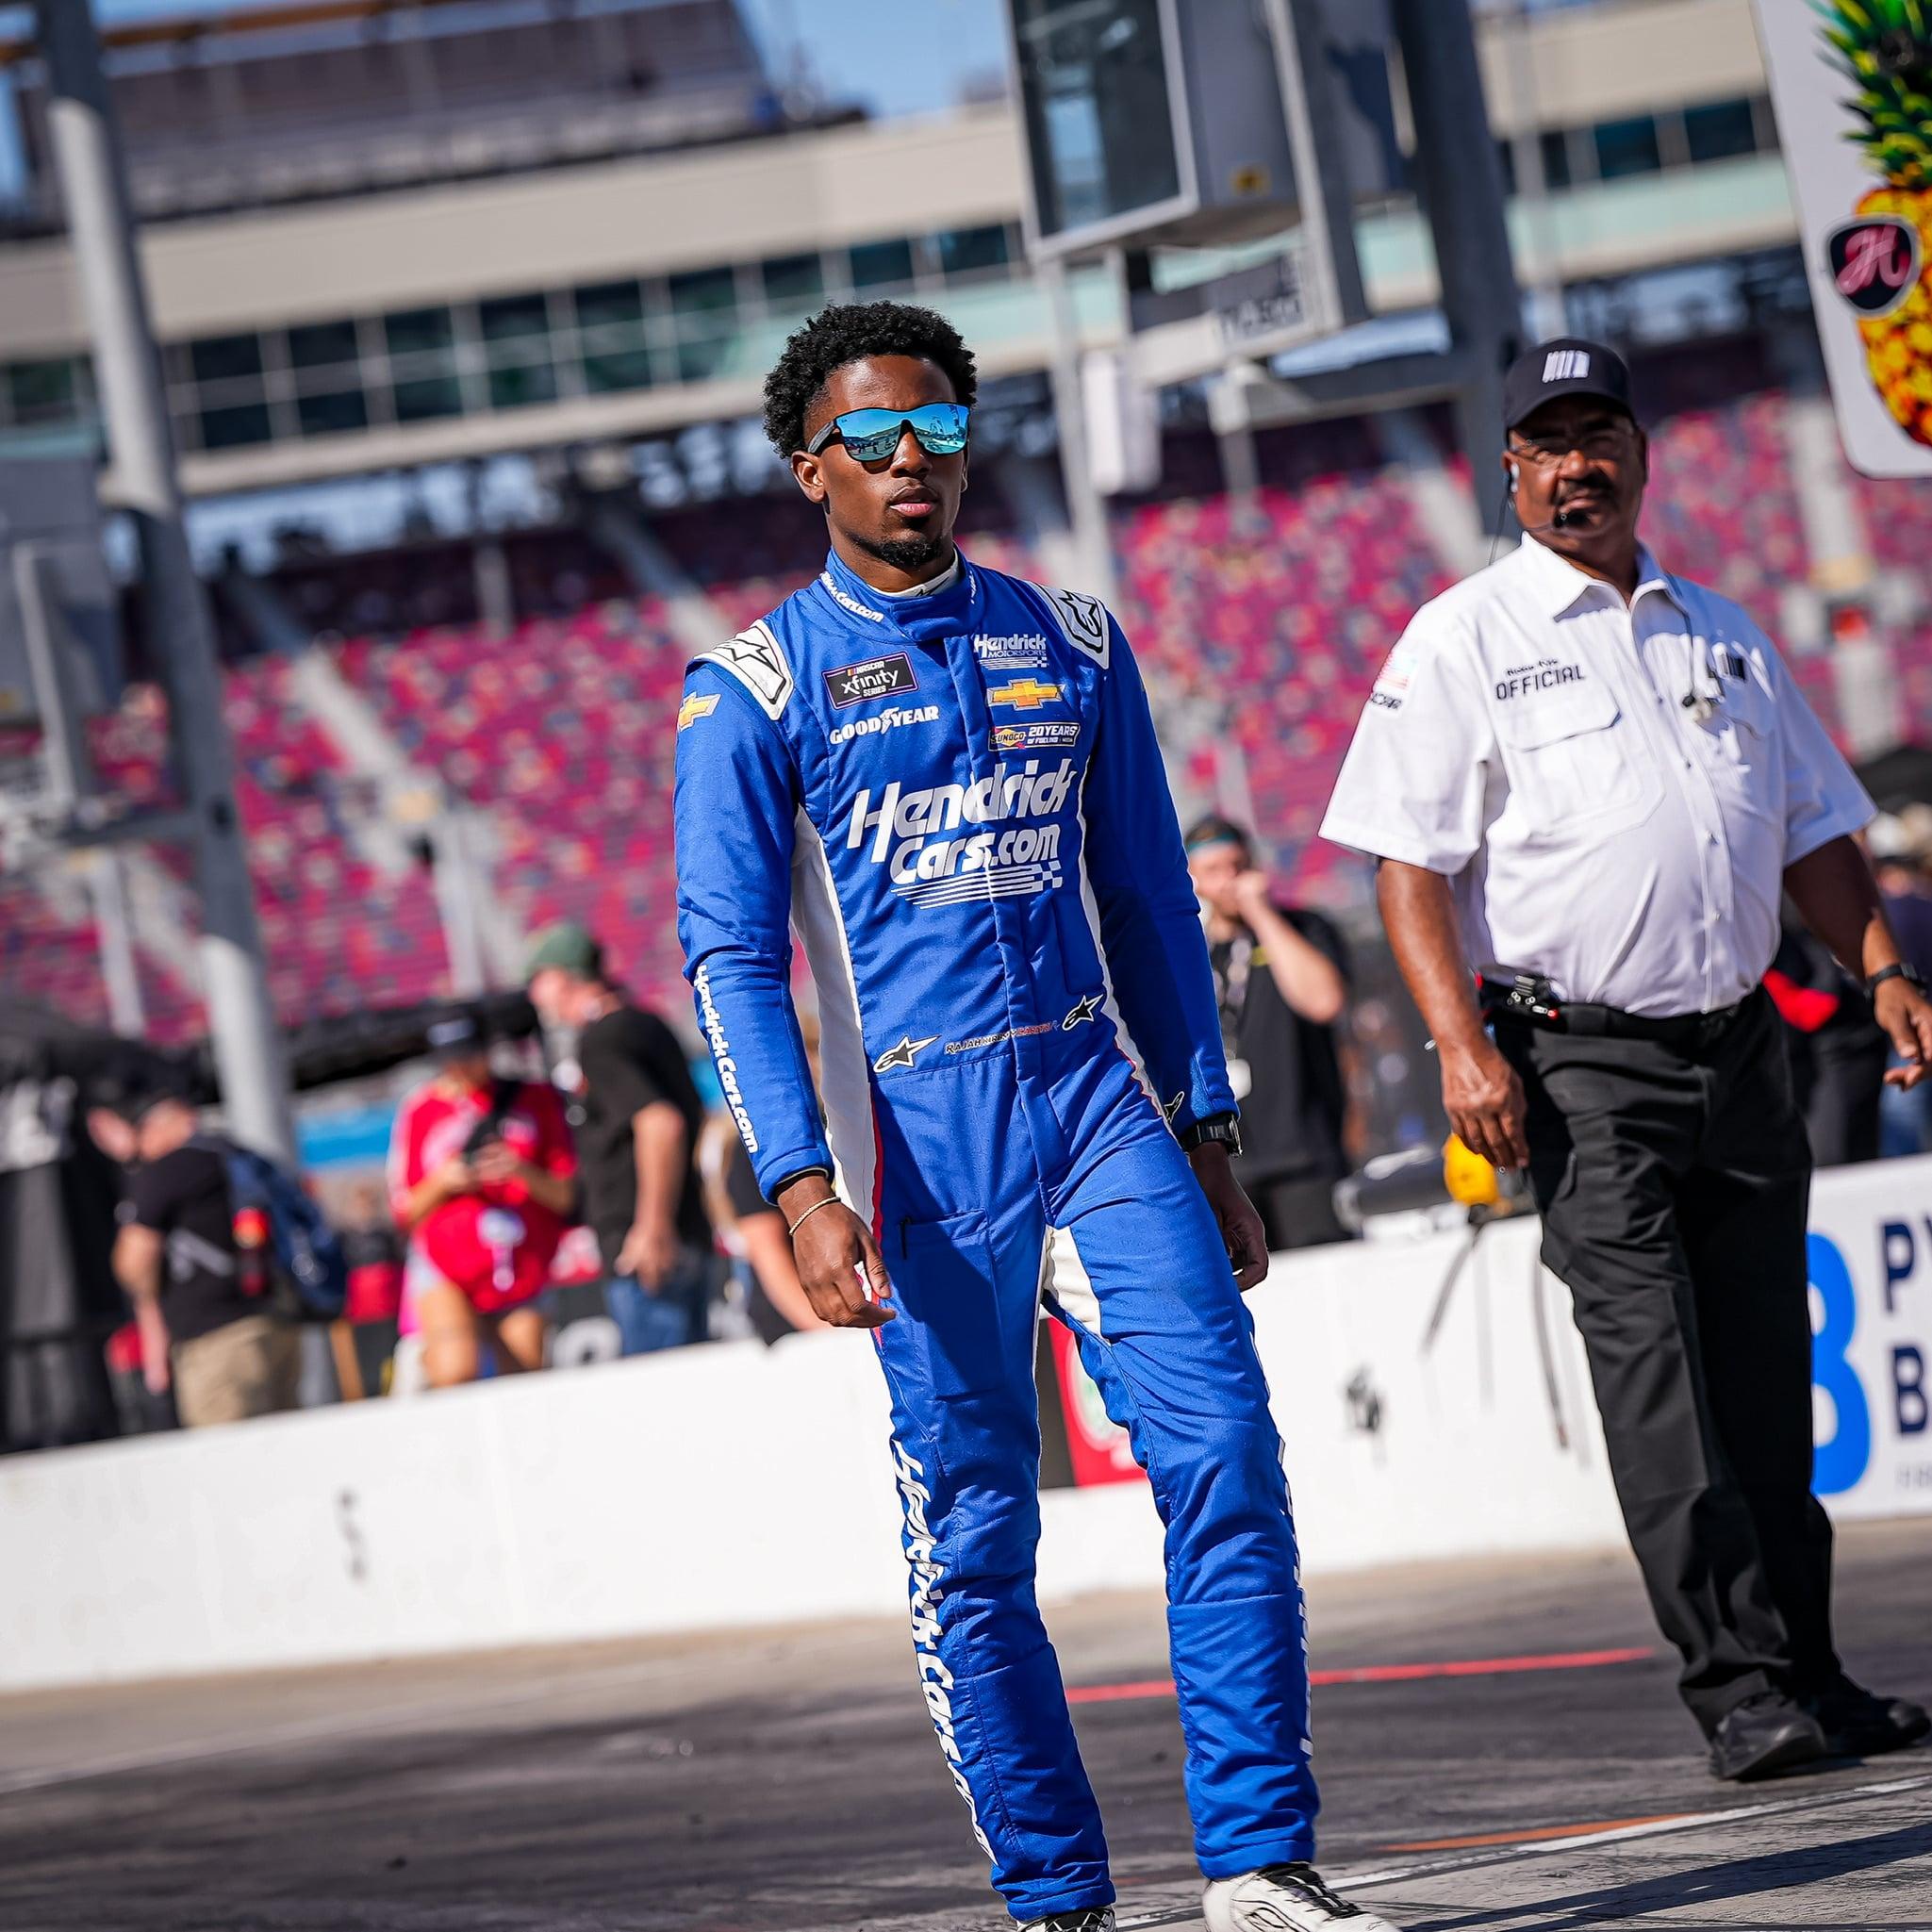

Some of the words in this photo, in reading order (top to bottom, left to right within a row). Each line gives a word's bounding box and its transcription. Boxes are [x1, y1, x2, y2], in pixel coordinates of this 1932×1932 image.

[973, 634, 1047, 658] Hendrick
[988, 650, 1047, 658] MOTORSPORTS
[841, 669, 899, 695] xfinity
[863, 685, 887, 697] SERIES
[1496, 666, 1585, 701] OFFICIAL
[830, 705, 940, 745] GOODYEAR
[990, 732, 1025, 745] SUNOCO
[847, 758, 1077, 863] Hendrick
[890, 823, 1061, 884] Cars.com
